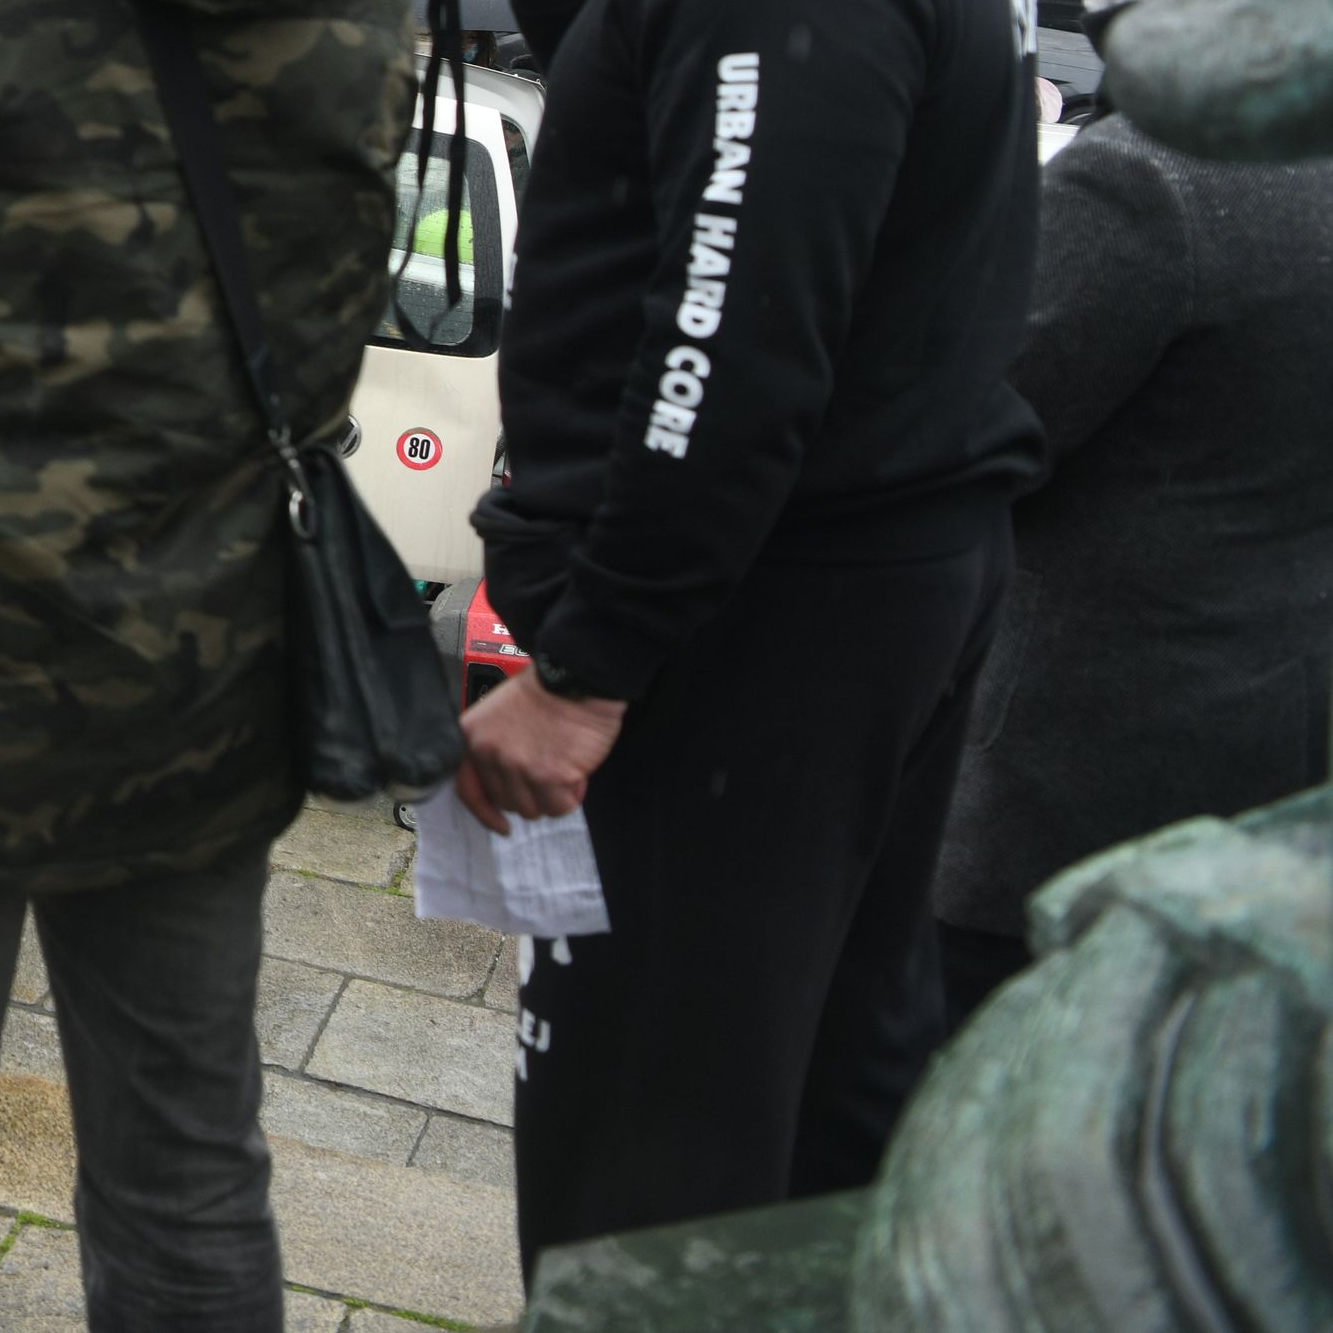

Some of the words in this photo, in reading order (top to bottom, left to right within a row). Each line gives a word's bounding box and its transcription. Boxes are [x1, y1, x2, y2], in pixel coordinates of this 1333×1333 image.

[703, 52, 760, 204] URBAN
[676, 213, 737, 339] HARD
[408, 436, 431, 460] 80
[644, 344, 712, 459] CORE
